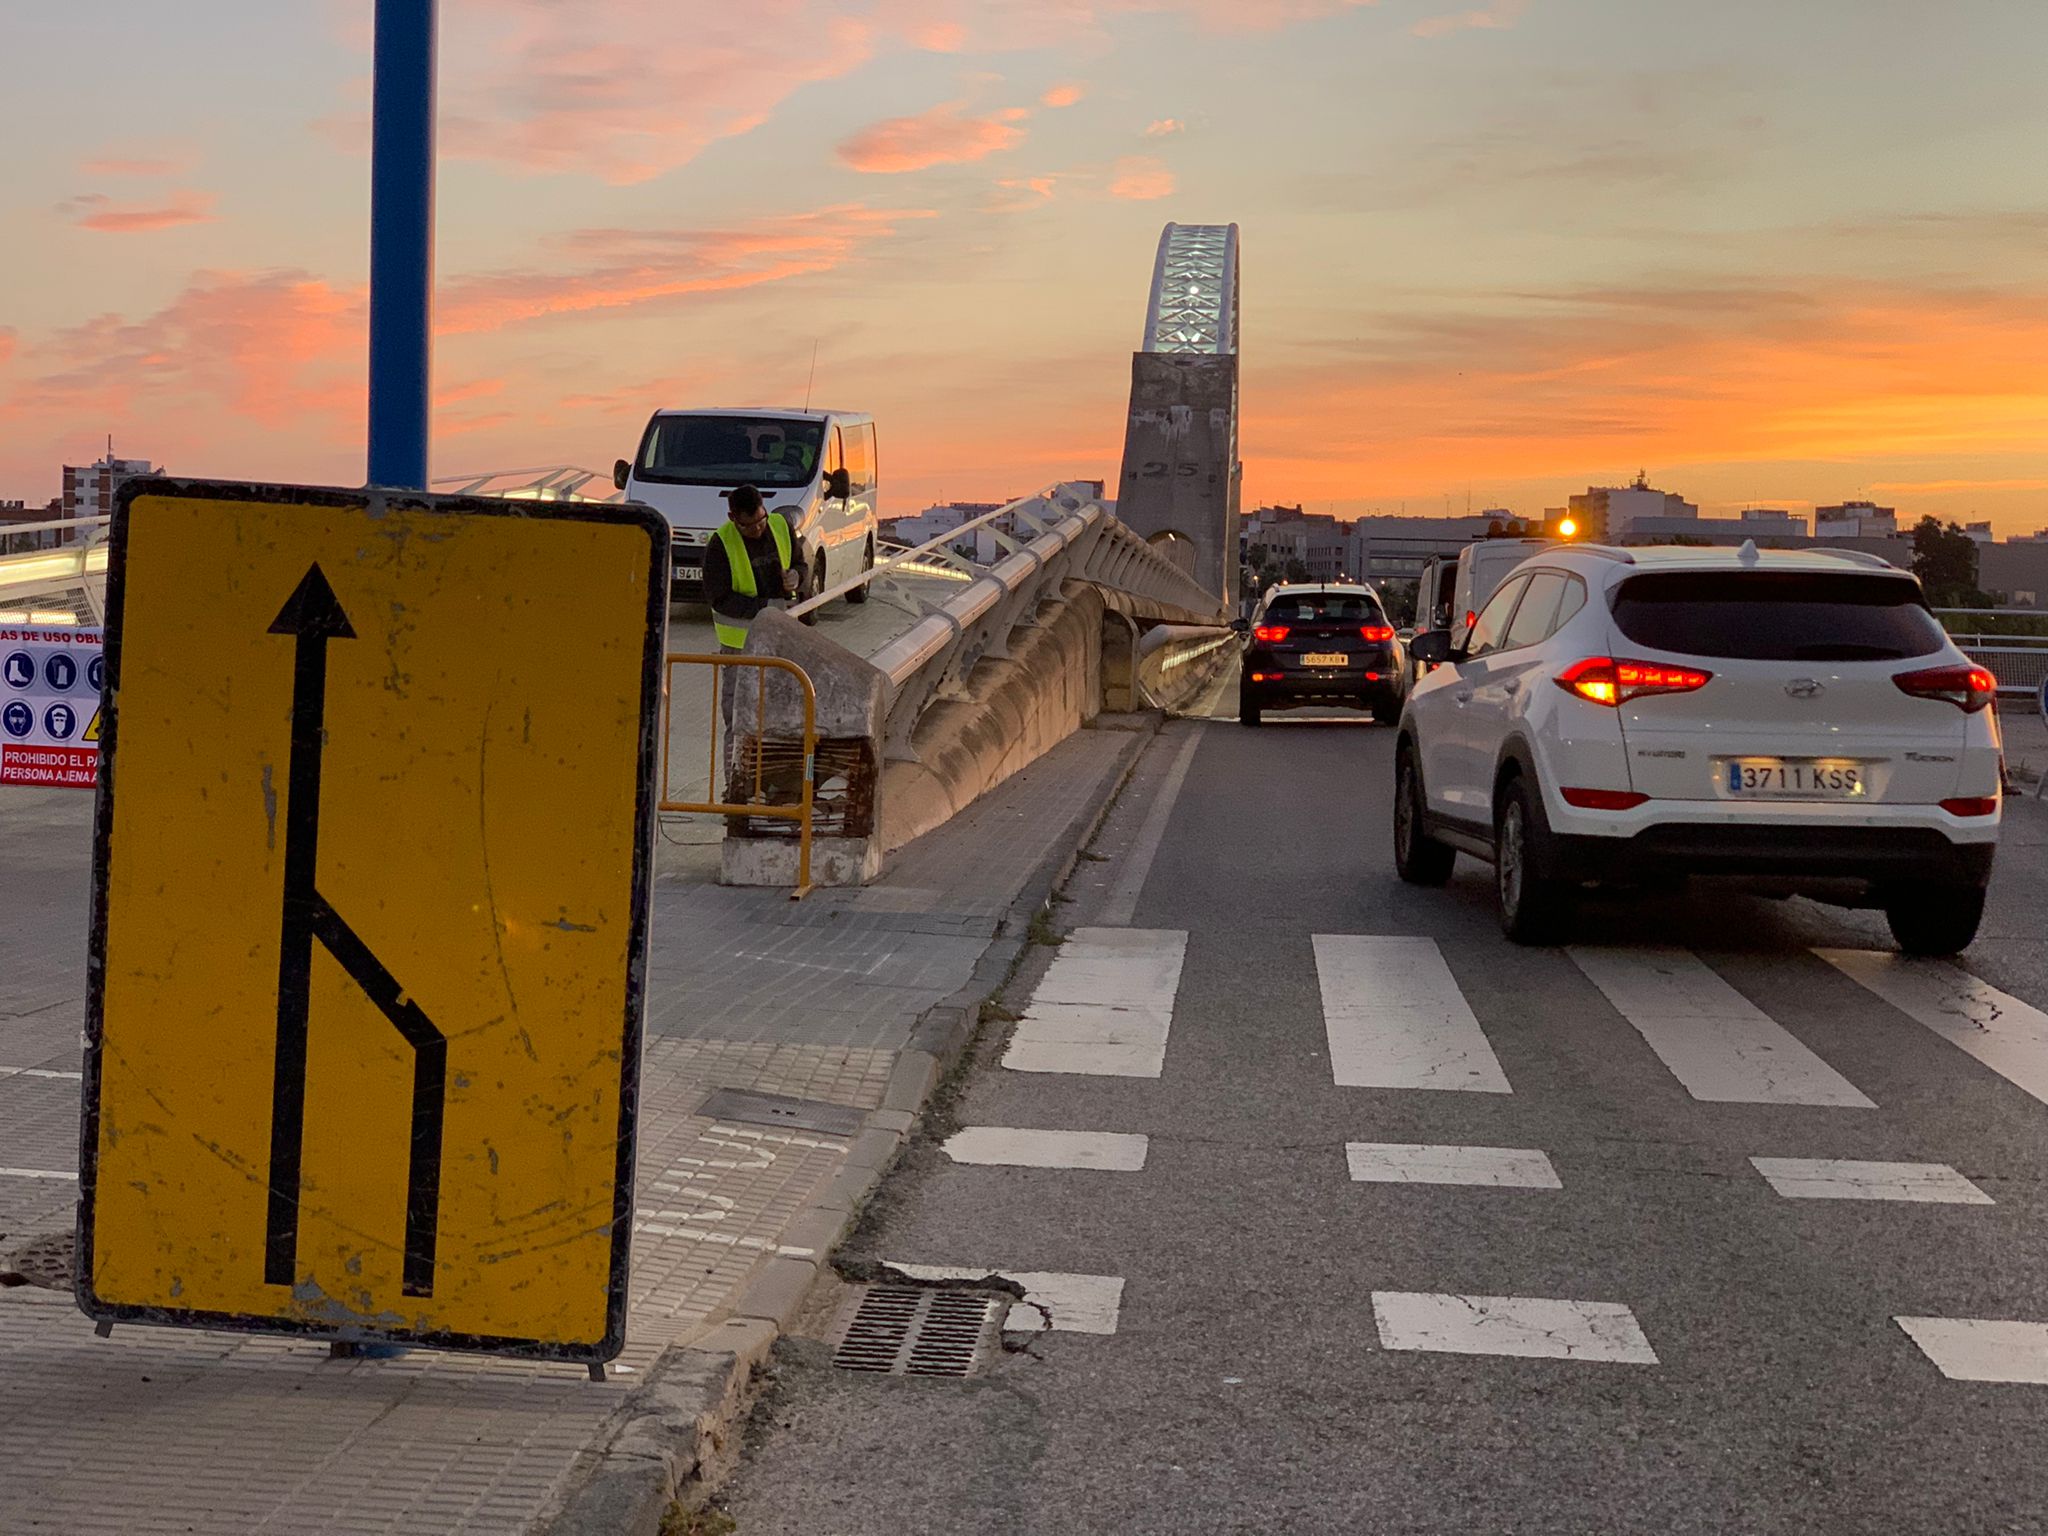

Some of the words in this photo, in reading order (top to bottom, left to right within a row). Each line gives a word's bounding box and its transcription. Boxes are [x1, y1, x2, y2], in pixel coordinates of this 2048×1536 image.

[21, 631, 40, 641] DE
[43, 632, 71, 643] USO
[76, 633, 103, 644] OBL
[5, 751, 67, 766] PROHIBIDO
[69, 754, 84, 767] EL
[3, 766, 54, 781] PERSONA
[55, 769, 90, 783] AJENA
[1743, 767, 1801, 790] 3711
[1813, 768, 1858, 791] KSS
